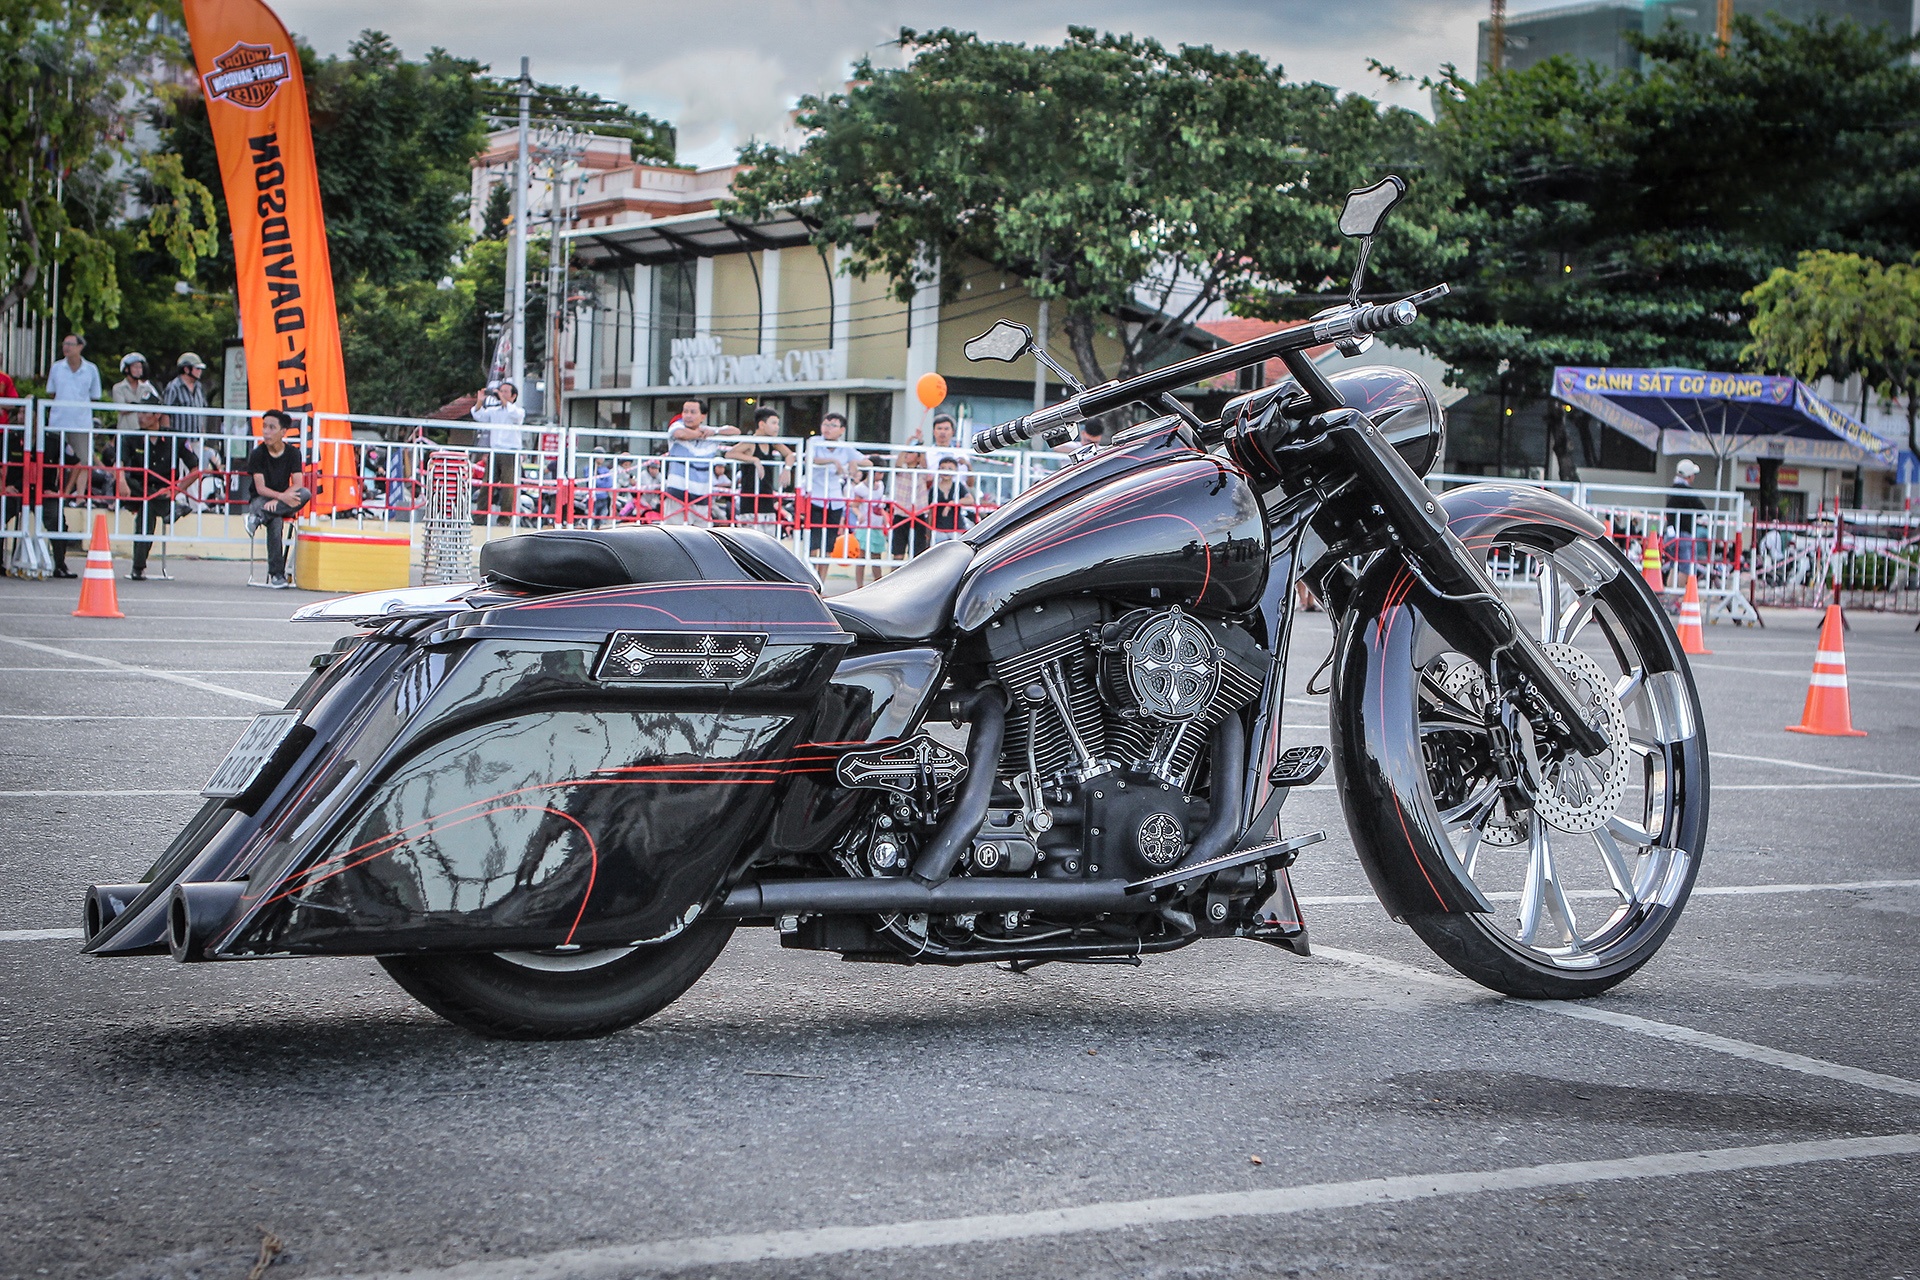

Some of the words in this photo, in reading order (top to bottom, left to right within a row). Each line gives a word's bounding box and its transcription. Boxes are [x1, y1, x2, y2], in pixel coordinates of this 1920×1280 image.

[1585, 367, 1633, 391] CẢNH
[1638, 371, 1675, 393] SÁT
[1679, 374, 1707, 395] CƠ
[1709, 374, 1763, 399] ĐỘNG
[240, 718, 288, 750] 59-A3
